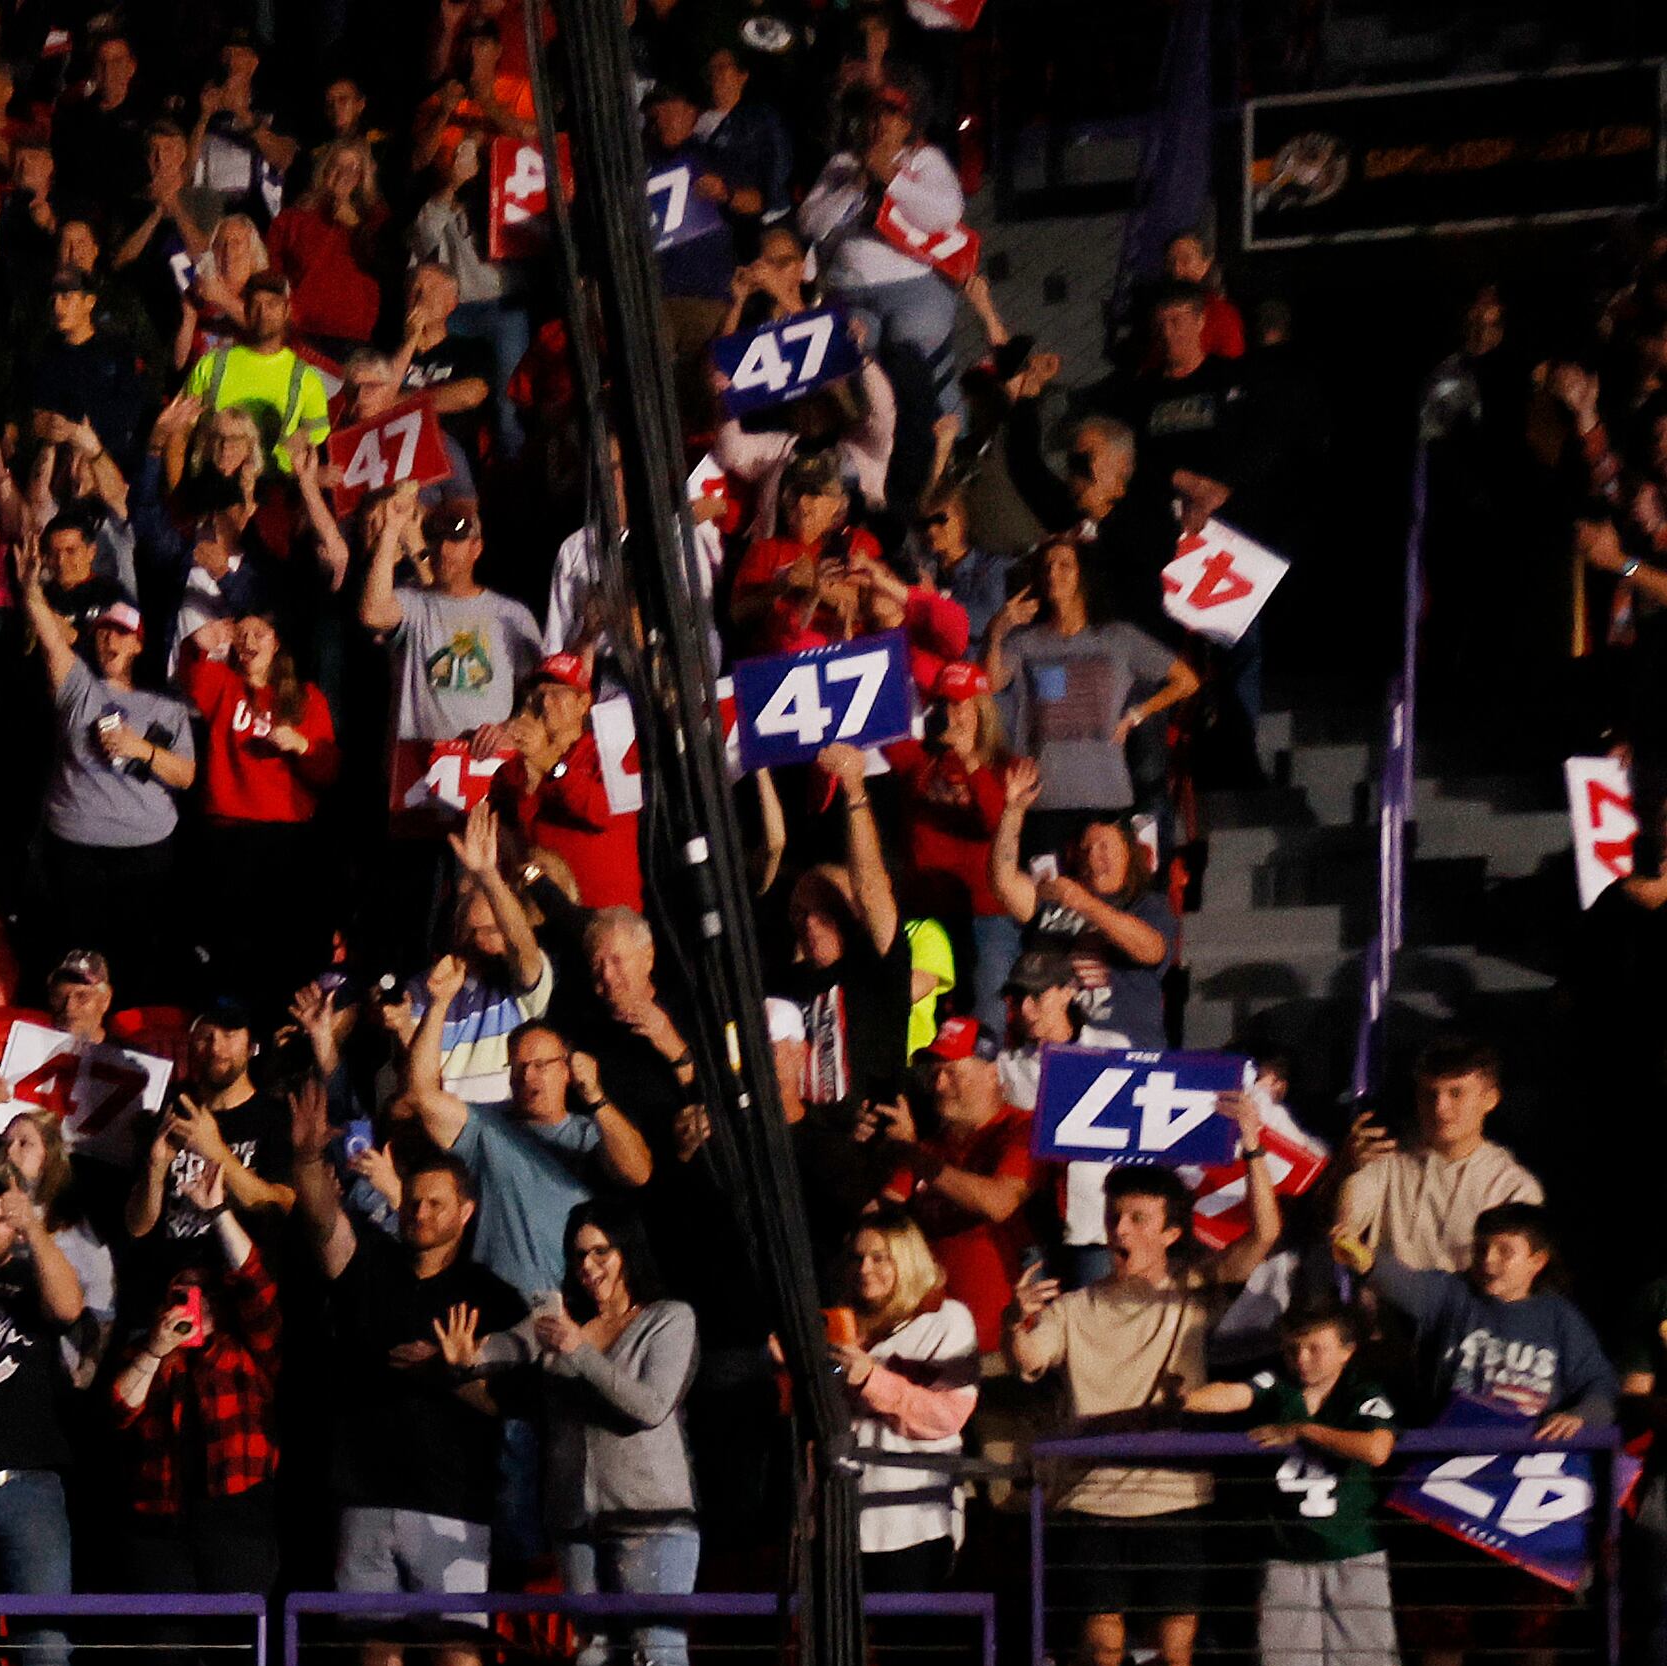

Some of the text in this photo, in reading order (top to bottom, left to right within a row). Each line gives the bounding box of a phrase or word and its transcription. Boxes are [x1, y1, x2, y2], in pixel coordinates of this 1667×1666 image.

[646, 164, 690, 234] 7
[731, 314, 834, 393] 47
[343, 408, 424, 491] 47
[754, 648, 889, 745] 47
[14, 1052, 150, 1135] 47
[1054, 1068, 1218, 1152] 47
[1275, 1455, 1338, 1518] 4
